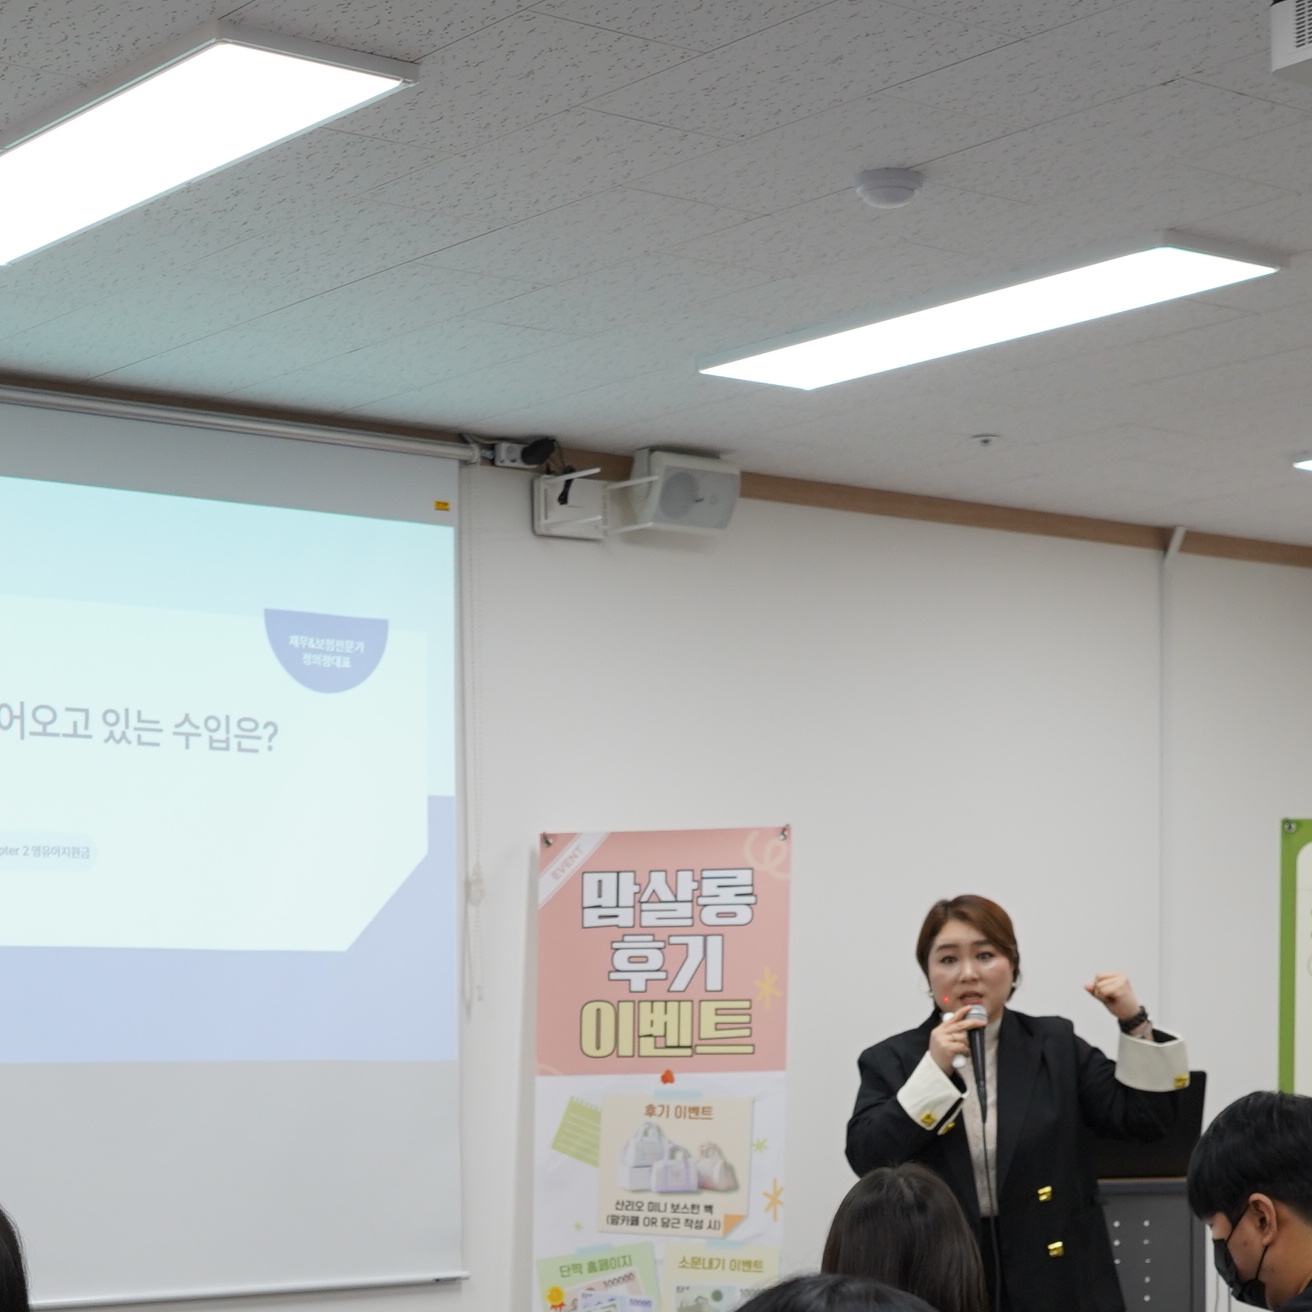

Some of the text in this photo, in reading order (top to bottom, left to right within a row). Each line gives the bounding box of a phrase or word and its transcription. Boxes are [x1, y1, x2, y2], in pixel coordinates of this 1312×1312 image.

[101, 707, 164, 747] 있는
[172, 712, 279, 754] 수입은?
[550, 844, 584, 881] EVENT
[581, 867, 757, 929] 맘살롱
[608, 934, 724, 993] 후기
[579, 999, 756, 1058] 이벤트
[644, 1104, 714, 1120] 후기 이벤트
[615, 1199, 644, 1212] 산리오
[647, 1201, 667, 1214] 미니
[642, 1217, 658, 1228] OR
[677, 1256, 765, 1273] 소문내기 이벤트
